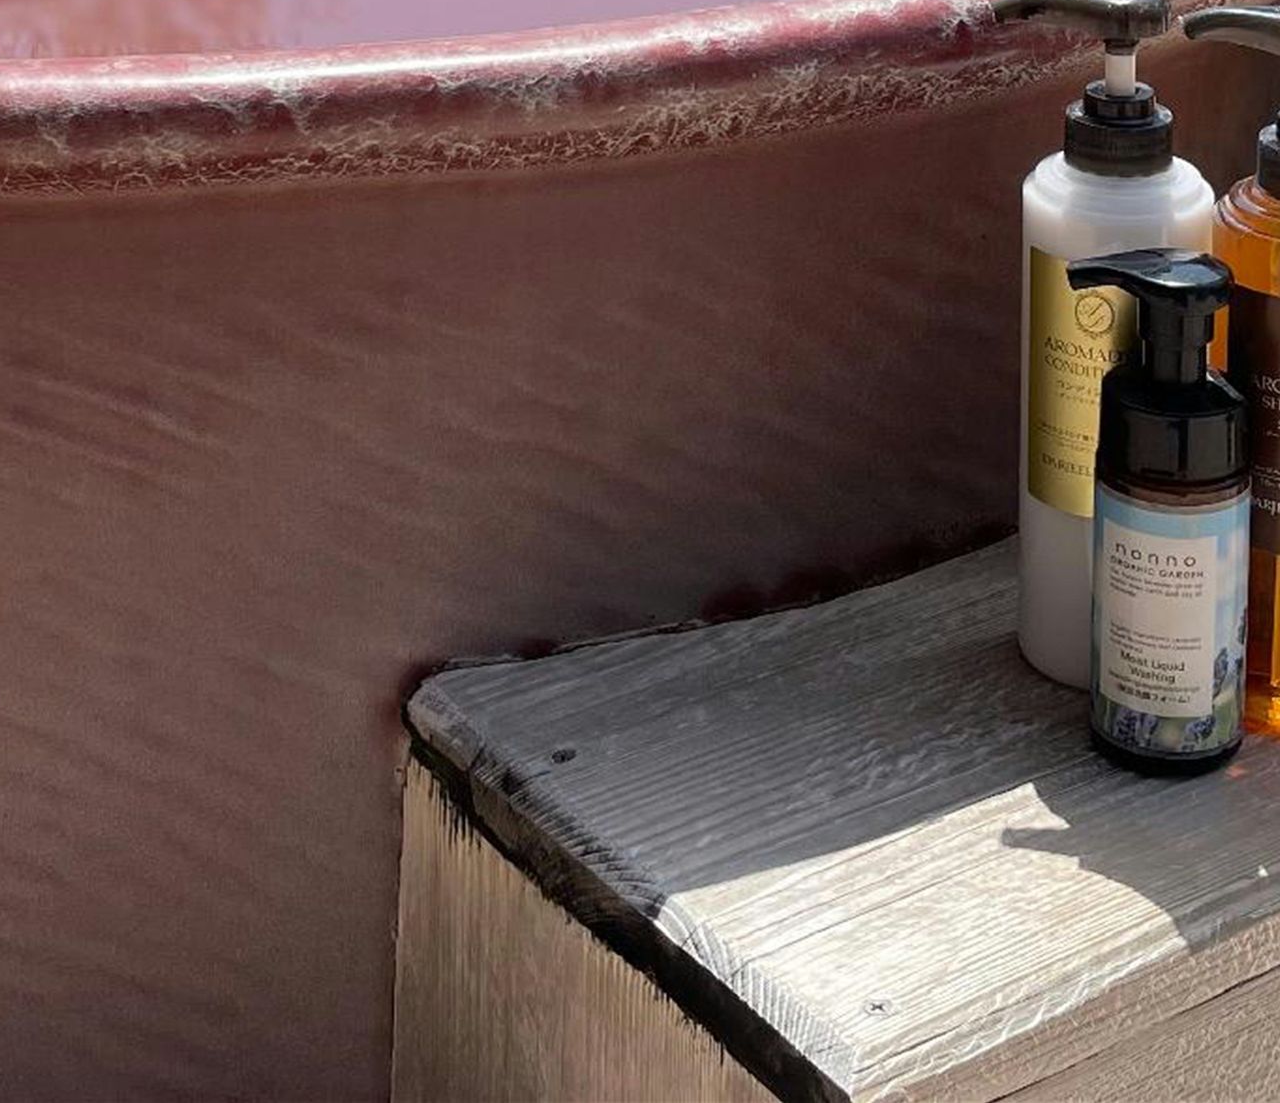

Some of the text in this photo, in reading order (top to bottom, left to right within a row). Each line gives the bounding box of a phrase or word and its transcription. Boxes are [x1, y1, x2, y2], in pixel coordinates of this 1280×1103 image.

[1043, 335, 1126, 364] AROMAD
[1044, 353, 1105, 379] CONDITI
[1041, 452, 1093, 477] DARJEEL
[1114, 541, 1197, 568] nonno
[1158, 568, 1205, 580] GARDEN
[1128, 663, 1177, 685] Washing
[1151, 659, 1186, 674] Liquid
